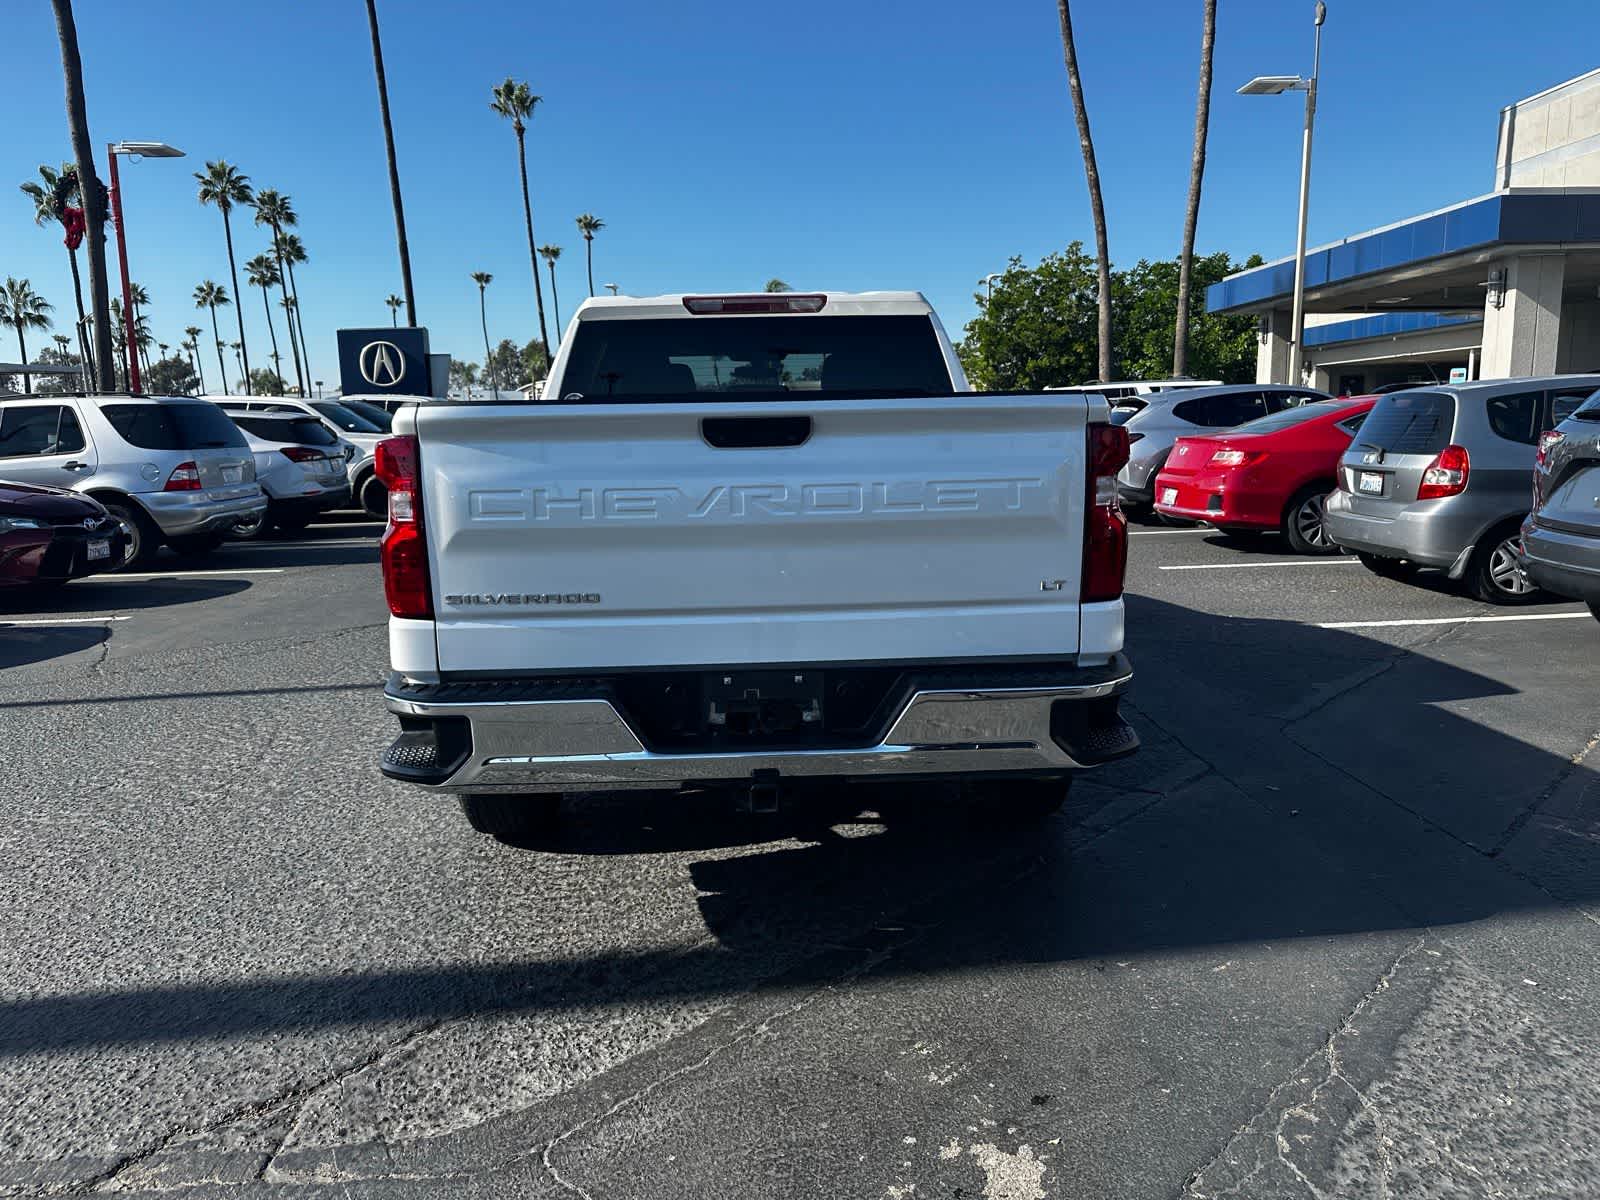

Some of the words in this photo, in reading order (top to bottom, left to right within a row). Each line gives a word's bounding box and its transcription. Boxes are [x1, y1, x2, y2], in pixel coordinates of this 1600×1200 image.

[468, 477, 1043, 521] CHEVROLET
[1040, 579, 1067, 591] LT
[445, 593, 601, 605] SILVERADO
